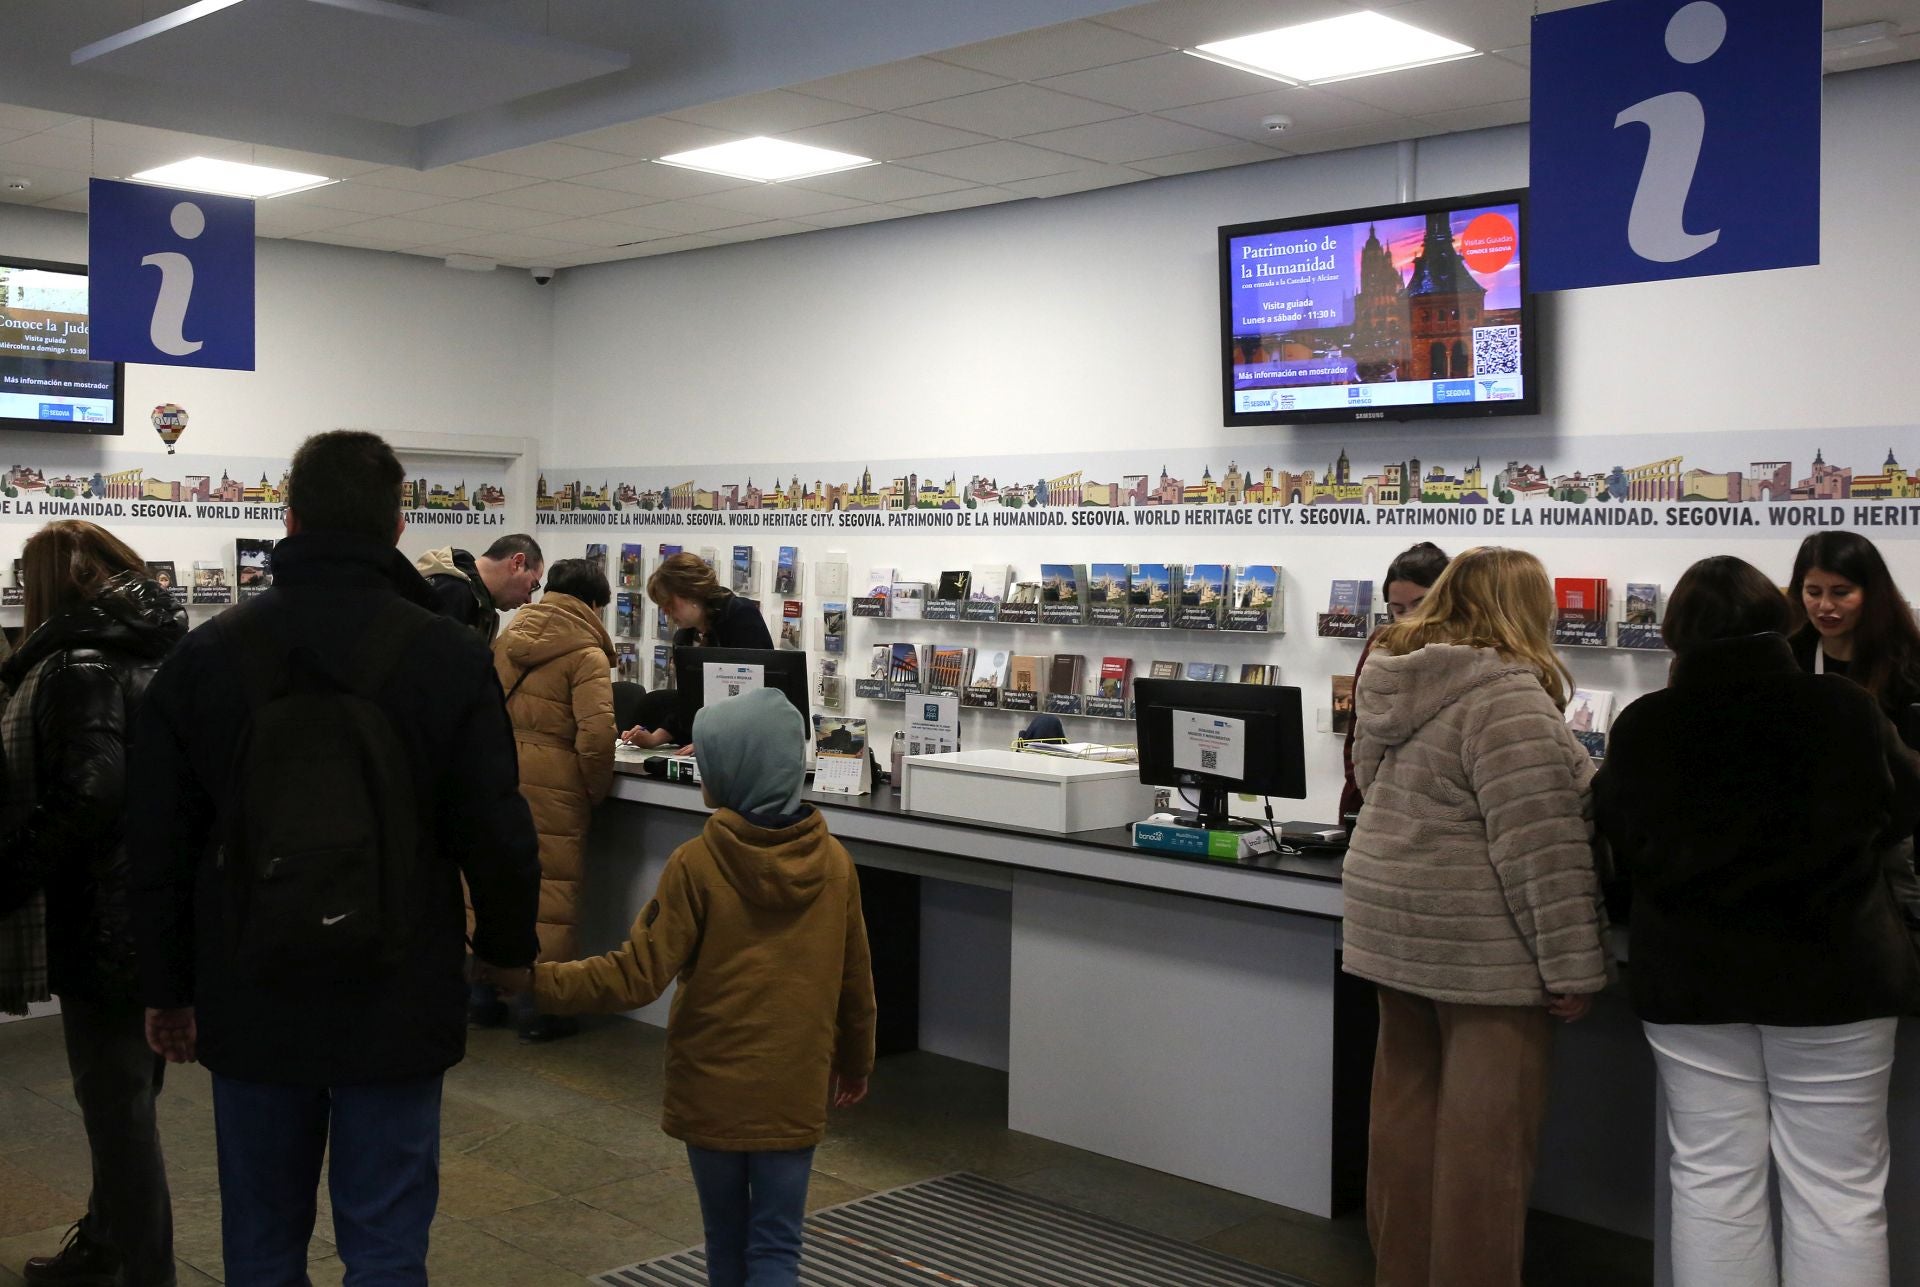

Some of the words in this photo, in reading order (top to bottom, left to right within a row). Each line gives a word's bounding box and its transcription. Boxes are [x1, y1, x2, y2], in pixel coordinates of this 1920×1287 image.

[1242, 238, 1317, 260] Patrimonio
[1321, 234, 1337, 251] de
[1241, 264, 1253, 279] la
[1256, 254, 1335, 277] Humanidad
[1253, 280, 1275, 288] entrada
[1262, 301, 1285, 311] Visita
[1286, 299, 1314, 311] guiada
[1242, 316, 1266, 325] Lunes
[1273, 312, 1302, 322] sábado
[1308, 310, 1329, 320] 11:30
[1330, 309, 1336, 318] h
[46, 318, 57, 332] la
[24, 334, 44, 342] Visita
[44, 336, 67, 345] guiada
[0, 342, 30, 351] Miércoles
[36, 344, 65, 355] domingo
[1238, 371, 1253, 380] Más
[1253, 369, 1297, 379] información
[1309, 366, 1349, 376] mostrador
[4, 375, 19, 384] Más
[20, 376, 63, 387] información
[73, 382, 110, 391] mostrador
[1445, 389, 1471, 397] SEGOVIA
[49, 409, 70, 417] SEGOVIA
[0, 500, 11, 514] E
[16, 501, 34, 515] LA
[39, 502, 126, 517] HUMANIDAD.
[131, 504, 192, 518] SEGOVIA.
[196, 505, 240, 519] WORLD
[466, 513, 480, 525] DE
[483, 513, 497, 525] LA
[560, 513, 606, 525] PATRIMONIO
[608, 513, 618, 525] DE
[620, 513, 631, 526] LA
[633, 513, 684, 526] HUMANIDAD.
[686, 513, 726, 526] SEGOVIA.
[729, 513, 760, 526] WORLD
[762, 513, 808, 526] HERITAGE
[810, 513, 835, 527] CITY.
[838, 513, 885, 527] SEGOVIA.
[888, 513, 954, 527] PATRIMONIO
[957, 512, 971, 526] DE
[975, 512, 989, 526] LA
[993, 511, 1067, 526] HUMANIDAD.
[1071, 510, 1130, 526] SEGOVIA.
[1134, 509, 1180, 525] WORLD
[1185, 508, 1252, 525] HERITAGE
[1258, 508, 1294, 524] CITY.
[1300, 508, 1371, 525] SEGOVIA.
[1376, 508, 1477, 525] PATRIMONIO
[1483, 508, 1505, 525] DE
[1511, 508, 1534, 525] LA
[1540, 507, 1658, 526] HUMANIDAD.
[1666, 507, 1760, 526] SEGOVIA.
[1768, 506, 1845, 526] WORLD
[1854, 506, 1920, 526] HERIT
[1567, 622, 1586, 630] Segovia
